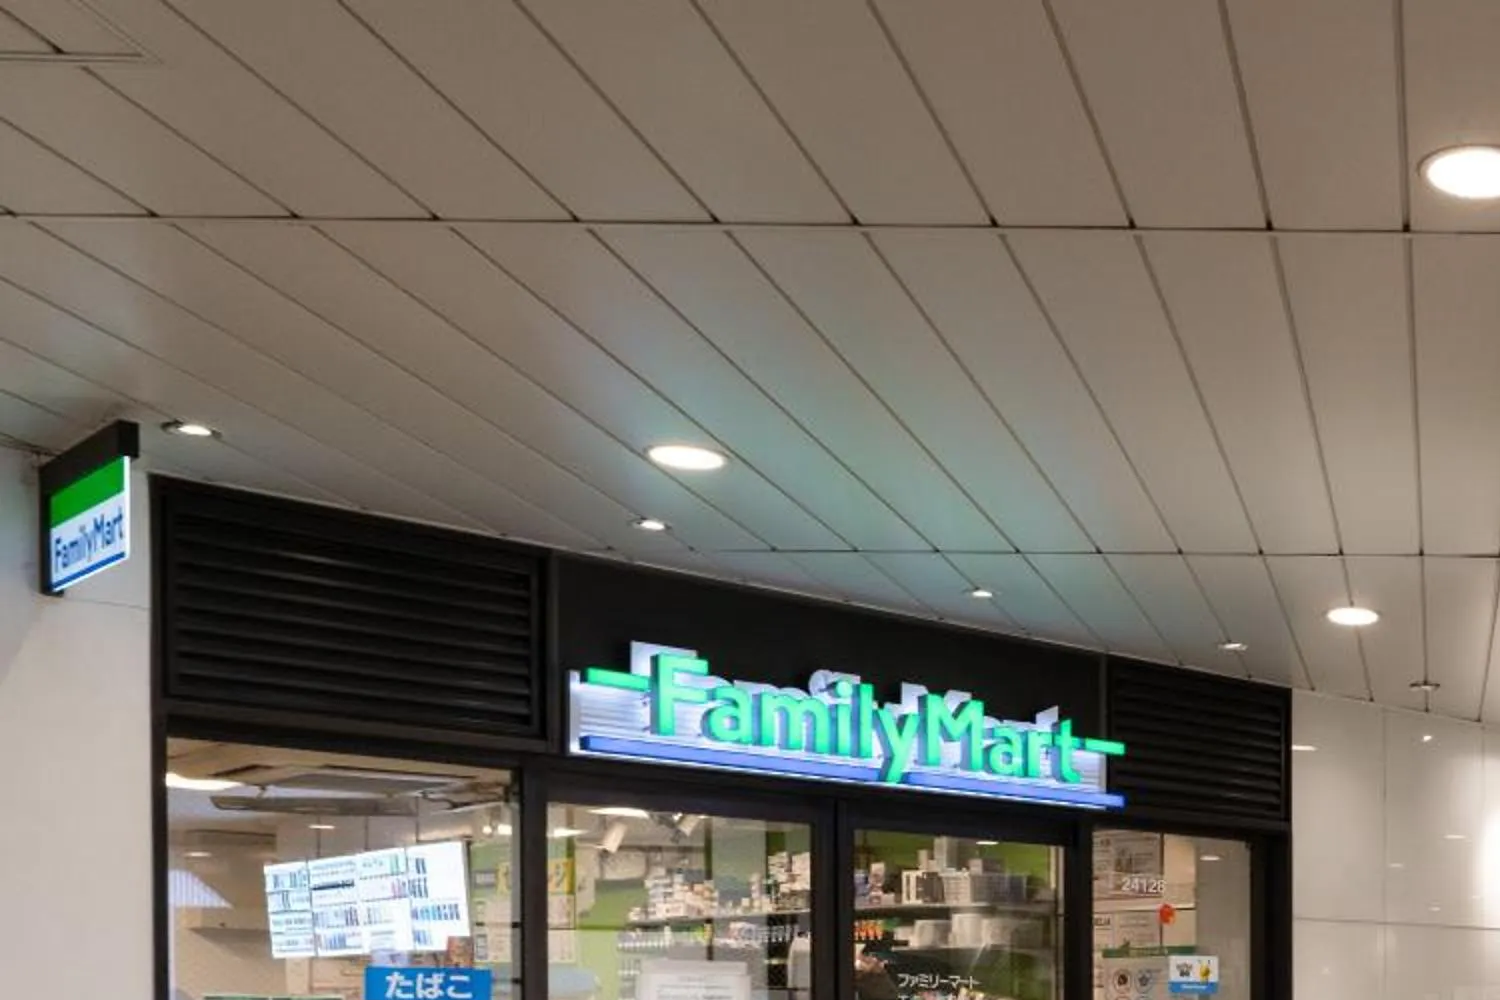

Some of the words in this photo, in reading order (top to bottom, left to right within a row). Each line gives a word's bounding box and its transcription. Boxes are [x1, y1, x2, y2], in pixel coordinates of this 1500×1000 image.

[55, 507, 123, 574] FamilyMart
[650, 653, 1084, 784] FamilyMart
[385, 971, 473, 999] たばこ
[898, 973, 980, 989] ファミリーマート
